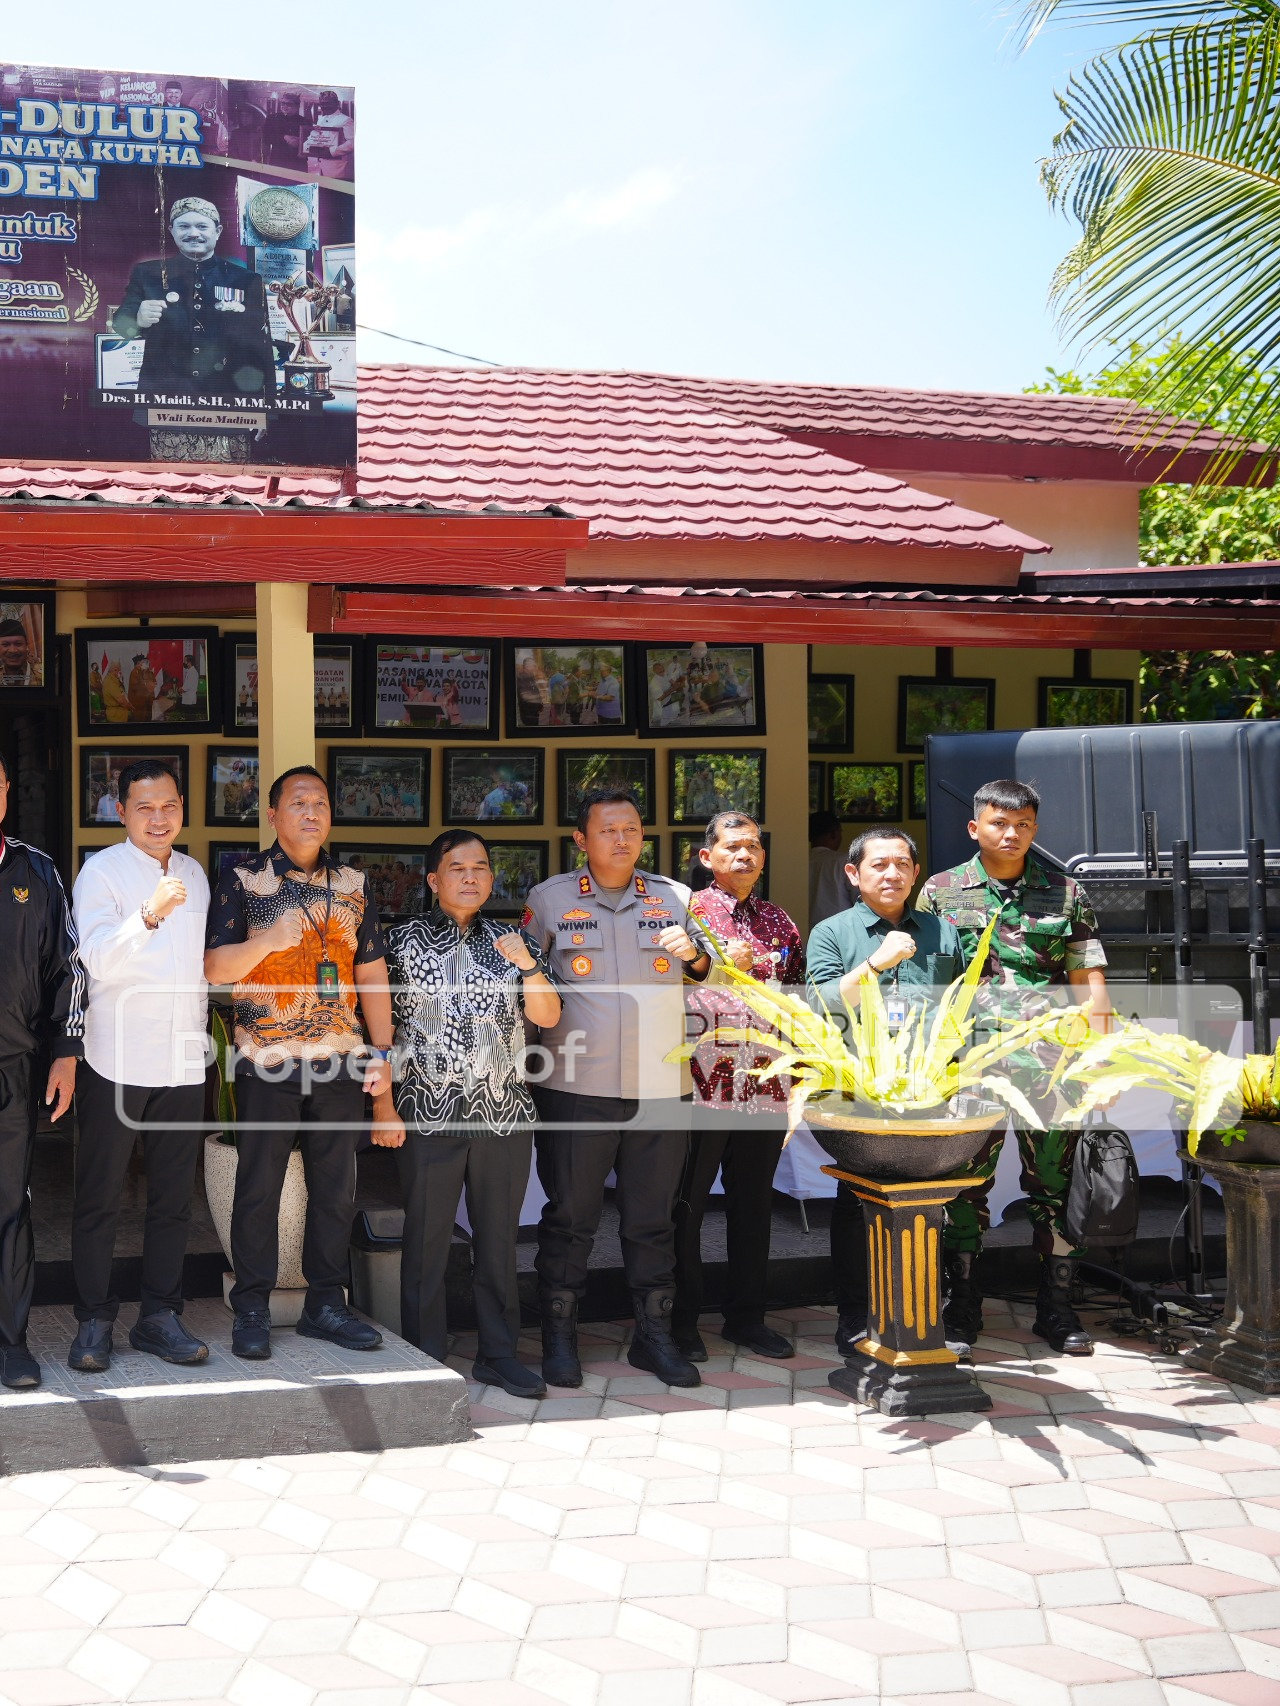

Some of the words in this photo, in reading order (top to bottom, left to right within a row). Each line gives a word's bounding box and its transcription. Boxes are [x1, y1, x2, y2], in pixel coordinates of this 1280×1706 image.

[1, 137, 84, 160] NATA
[91, 142, 201, 166] KUTHA
[102, 392, 130, 404] Drs.
[134, 393, 150, 404] H.
[154, 394, 195, 407] Maidi,
[198, 396, 231, 408] S.H.,
[234, 397, 271, 410] M.M.,
[275, 399, 310, 411] M.Pd
[156, 413, 183, 423] Wali
[186, 413, 213, 424] Kota
[215, 415, 258, 425] Madiun
[377, 667, 444, 678] PASANGAN
[447, 669, 488, 679] CALON
[557, 920, 598, 931] WIWIN
